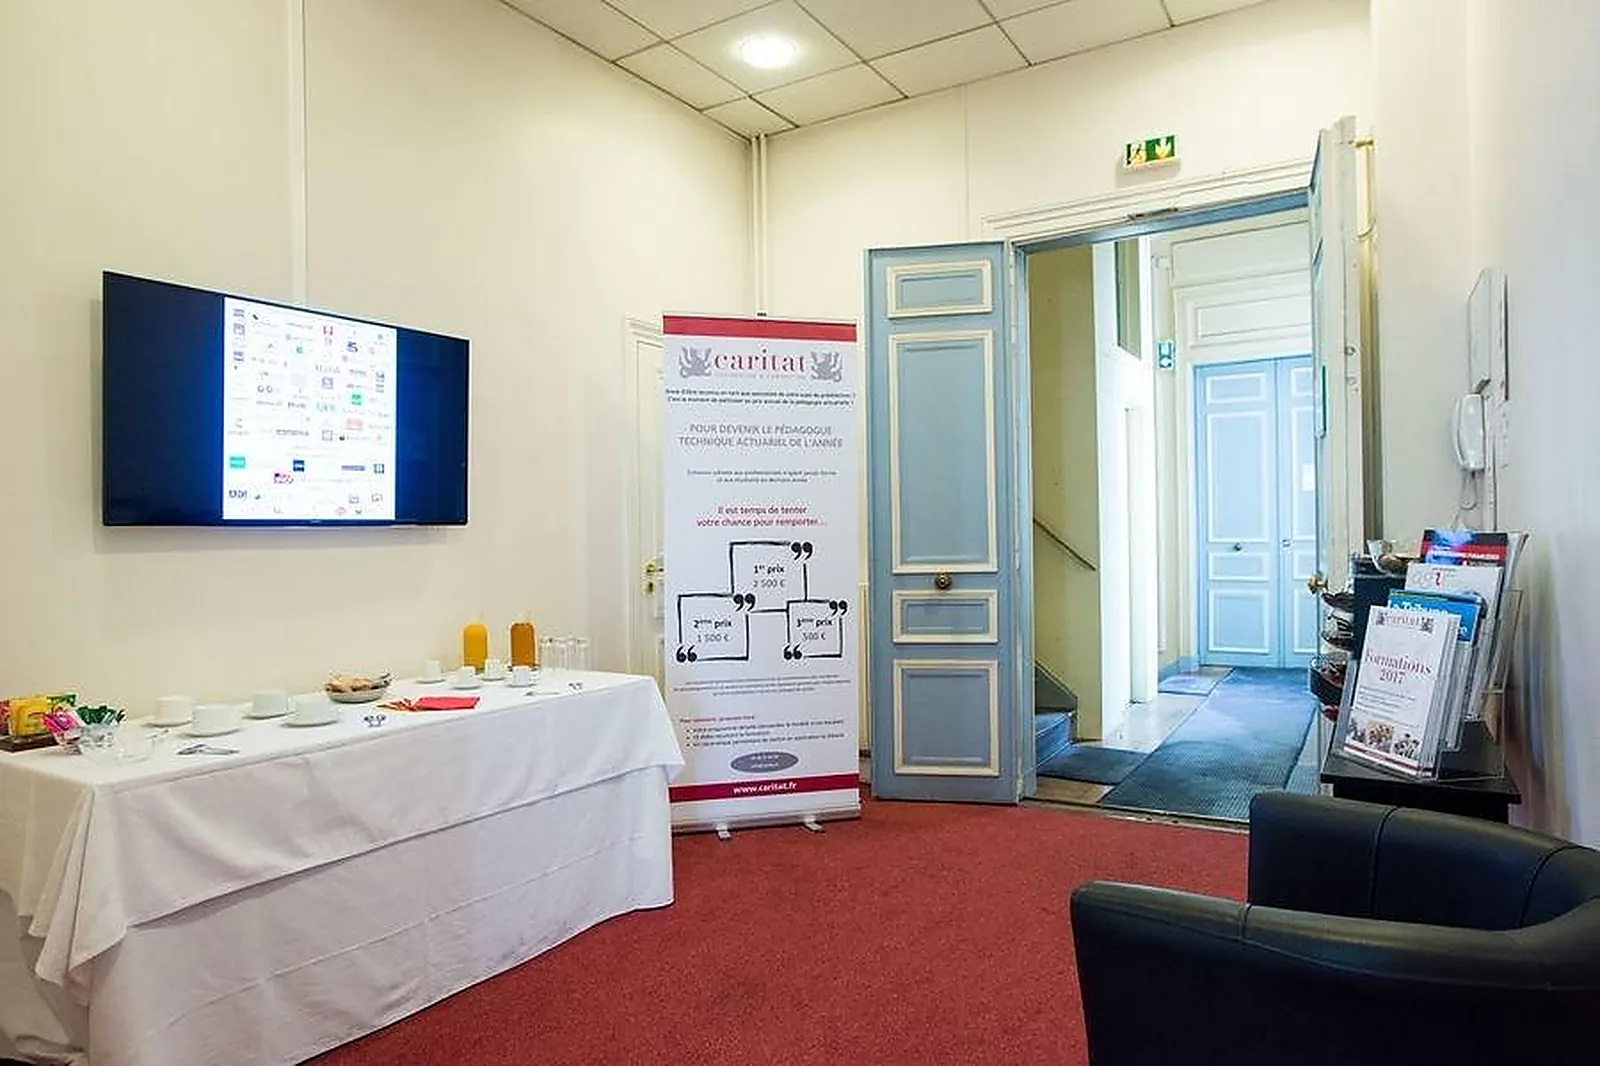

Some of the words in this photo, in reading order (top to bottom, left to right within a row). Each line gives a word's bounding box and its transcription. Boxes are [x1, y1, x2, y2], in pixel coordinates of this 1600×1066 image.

[713, 349, 806, 372] caritat
[690, 424, 718, 434] POUR
[719, 424, 759, 435] DEVENIR
[761, 425, 772, 435] LE
[679, 437, 733, 448] TECHNIQUE
[736, 437, 787, 448] ACTUARIEL
[788, 438, 802, 448] DE
[740, 507, 766, 516] temps
[767, 506, 779, 514] de
[697, 519, 720, 527] votre
[722, 518, 751, 527] chance
[753, 519, 774, 529] pour
[767, 565, 785, 575] prix
[714, 620, 732, 629] prix
[816, 618, 833, 628] prix
[1365, 648, 1432, 675] Formations
[1379, 668, 1406, 685] 2017
[733, 781, 797, 794] www.caritat.fr
